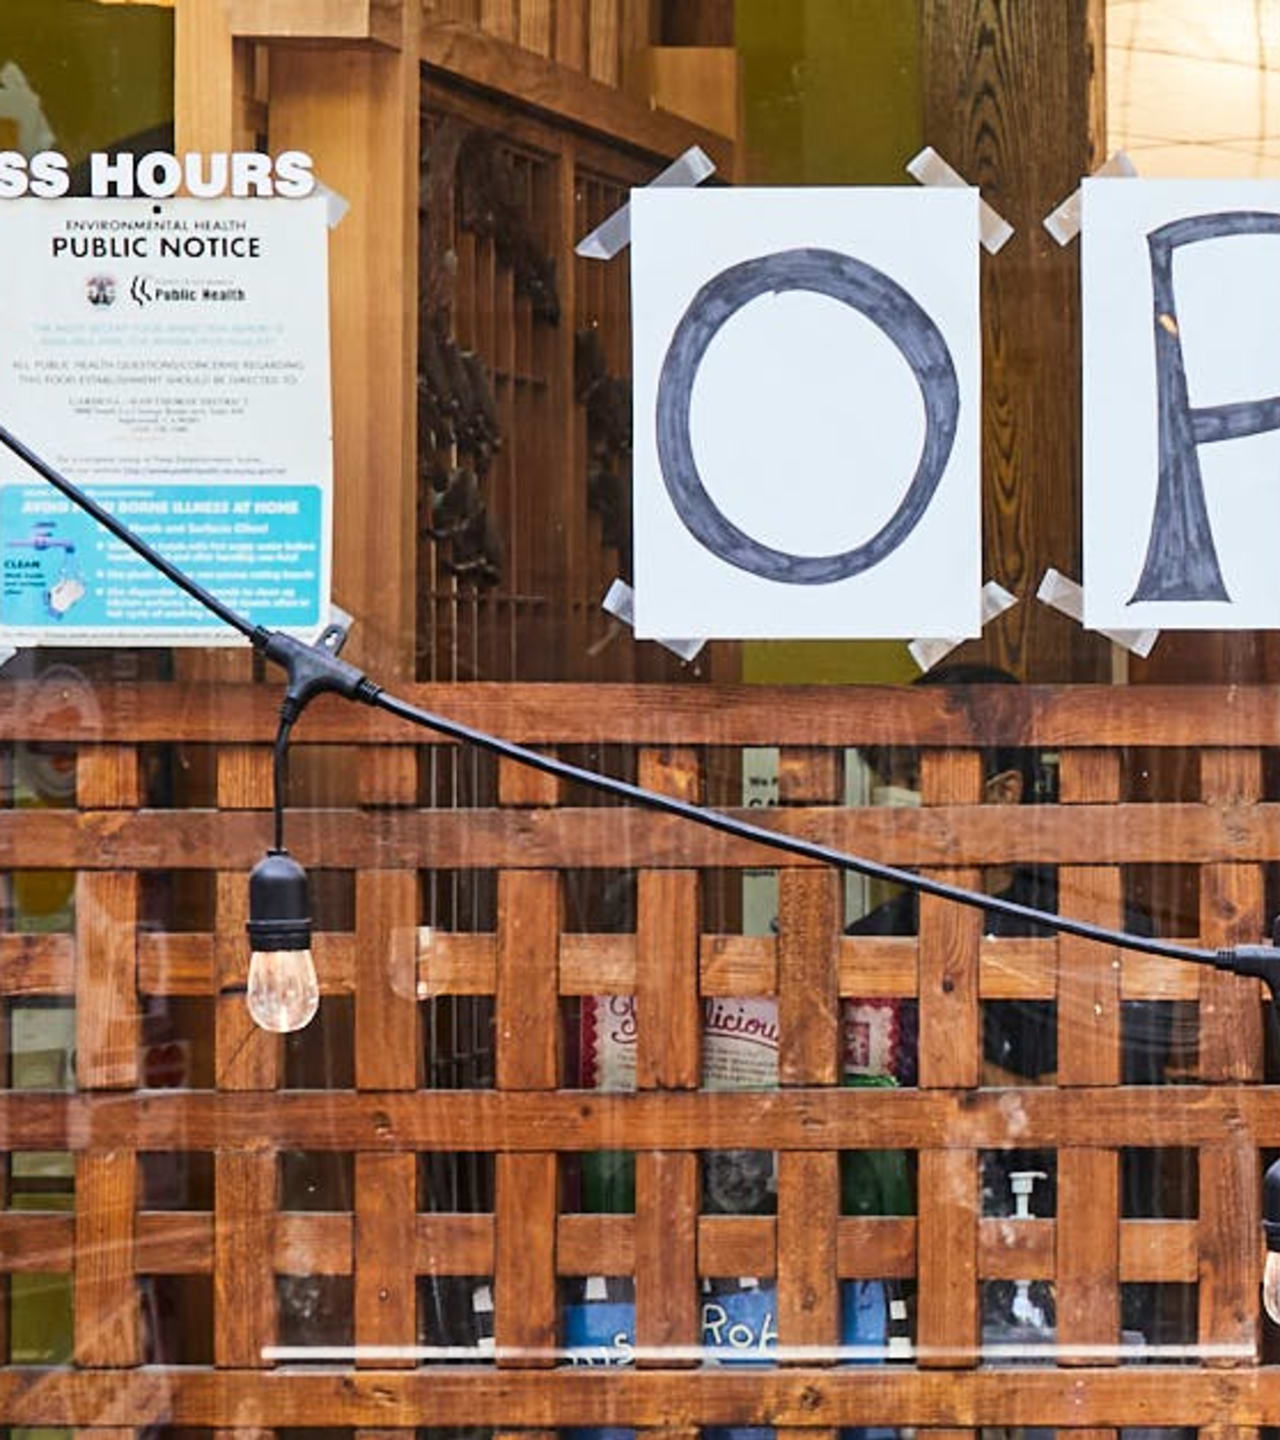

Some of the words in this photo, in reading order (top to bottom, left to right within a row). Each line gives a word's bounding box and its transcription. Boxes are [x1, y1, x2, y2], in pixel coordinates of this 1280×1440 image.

[91, 151, 315, 198] HOURS
[65, 220, 188, 231] ENVIRONMENTAL
[195, 220, 246, 230] HEALTH
[52, 238, 147, 257] PUBLIC
[161, 238, 260, 257] NOTICE
[155, 288, 196, 301] Public
[202, 288, 245, 301] Health
